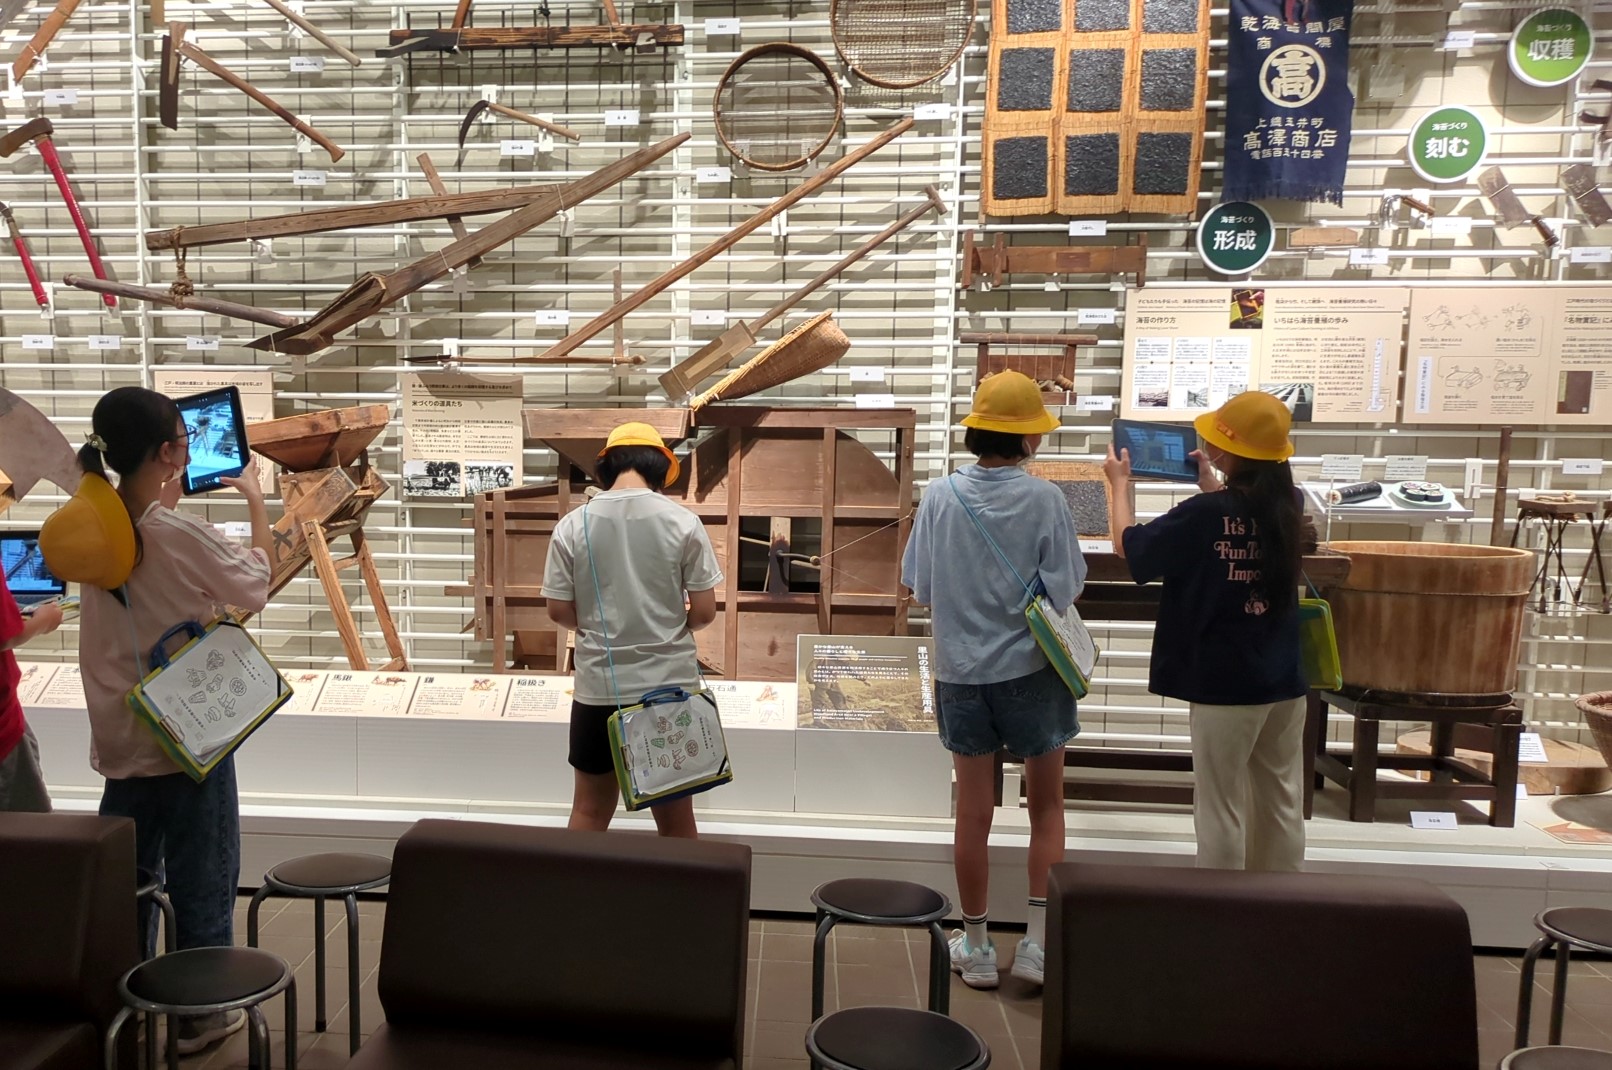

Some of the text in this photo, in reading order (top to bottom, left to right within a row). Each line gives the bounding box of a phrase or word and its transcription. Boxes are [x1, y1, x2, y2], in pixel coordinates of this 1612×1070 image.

[1536, 24, 1573, 33] 海苔づくり
[1527, 37, 1575, 62] 収穫
[1431, 122, 1468, 131] 海苔づくり
[1424, 136, 1470, 159] 刻む
[1220, 216, 1255, 225] 海苔づくり
[1213, 229, 1258, 252] 形成
[1135, 316, 1177, 325] 海苔の作り方
[411, 400, 463, 408] 米づくりの道具たち
[1222, 516, 1246, 536] It's
[1213, 541, 1247, 560] Fun
[917, 646, 934, 713] 里山の生活と生産用具
